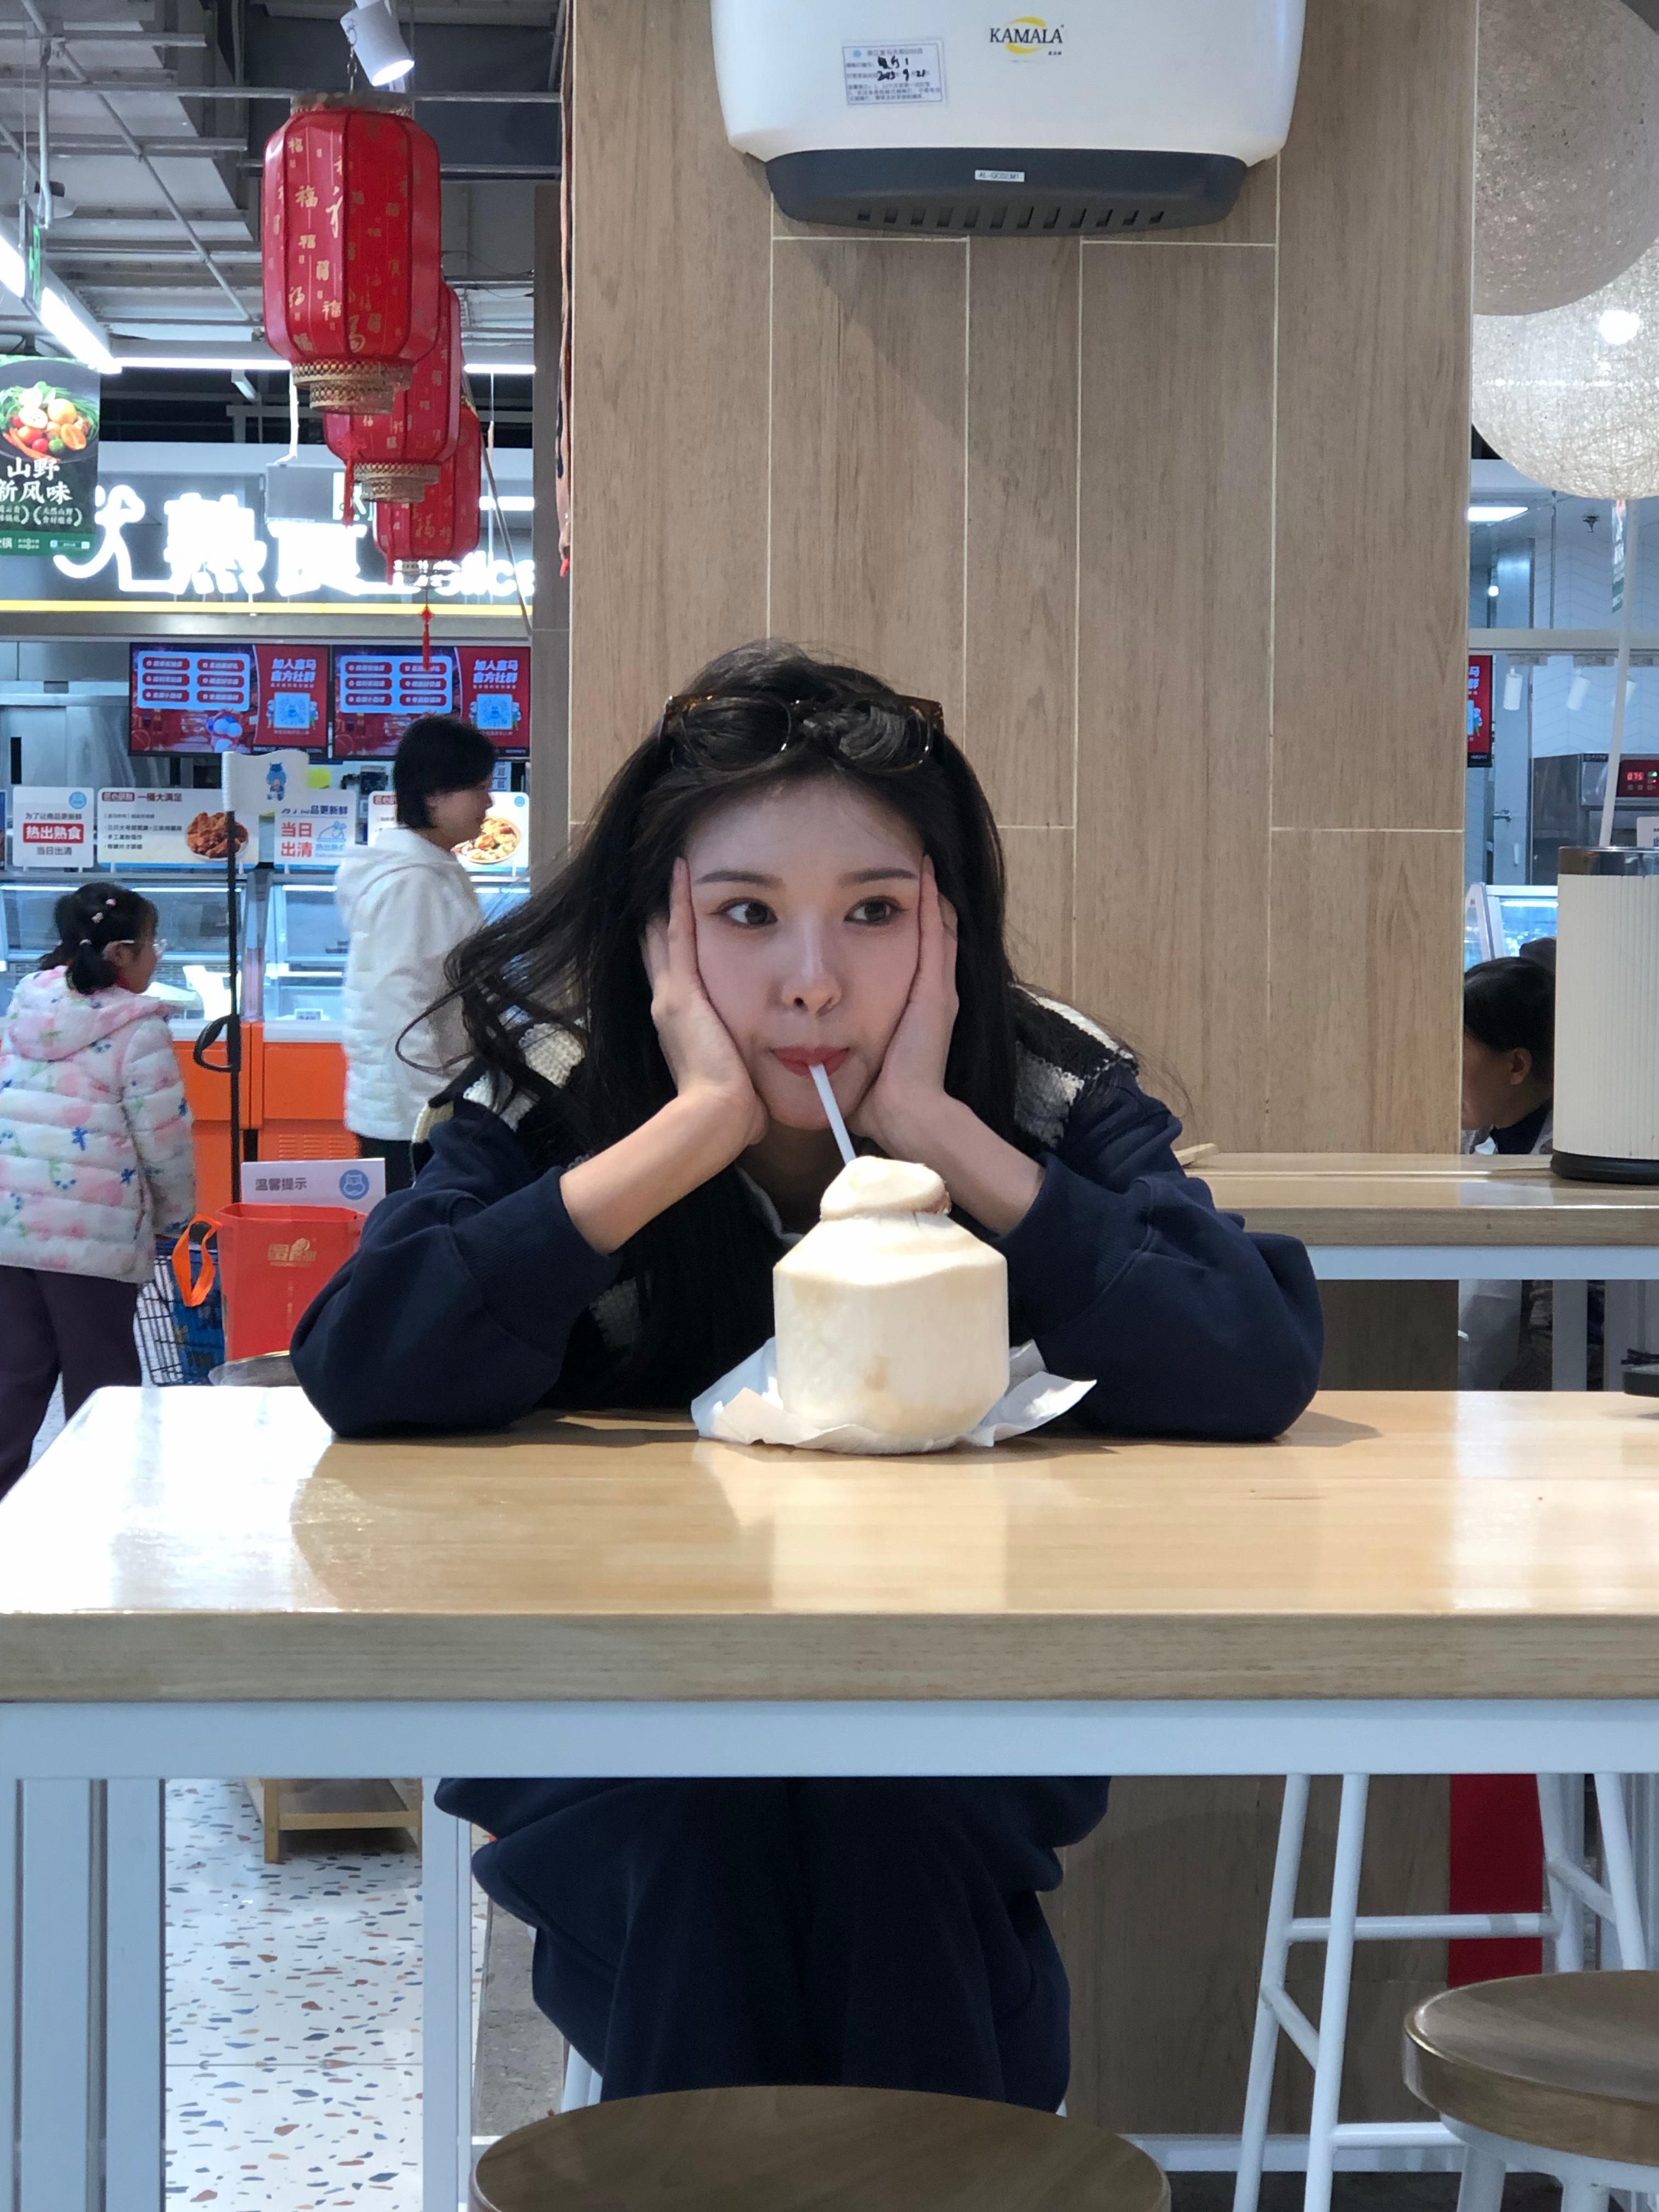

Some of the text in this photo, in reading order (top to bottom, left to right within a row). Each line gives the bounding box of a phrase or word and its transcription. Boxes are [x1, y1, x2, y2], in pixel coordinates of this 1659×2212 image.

[989, 28, 1063, 43] KAMALA
[7, 456, 60, 481] 山野
[0, 478, 73, 505] 新风味
[270, 670, 316, 683] 官方社群
[473, 672, 518, 684] 官方社群
[26, 826, 82, 840] 热出熟食
[281, 821, 313, 838] 当日
[37, 847, 72, 855] 当日出清
[281, 842, 313, 857] 出清
[255, 1177, 307, 1191] 温馨提示
